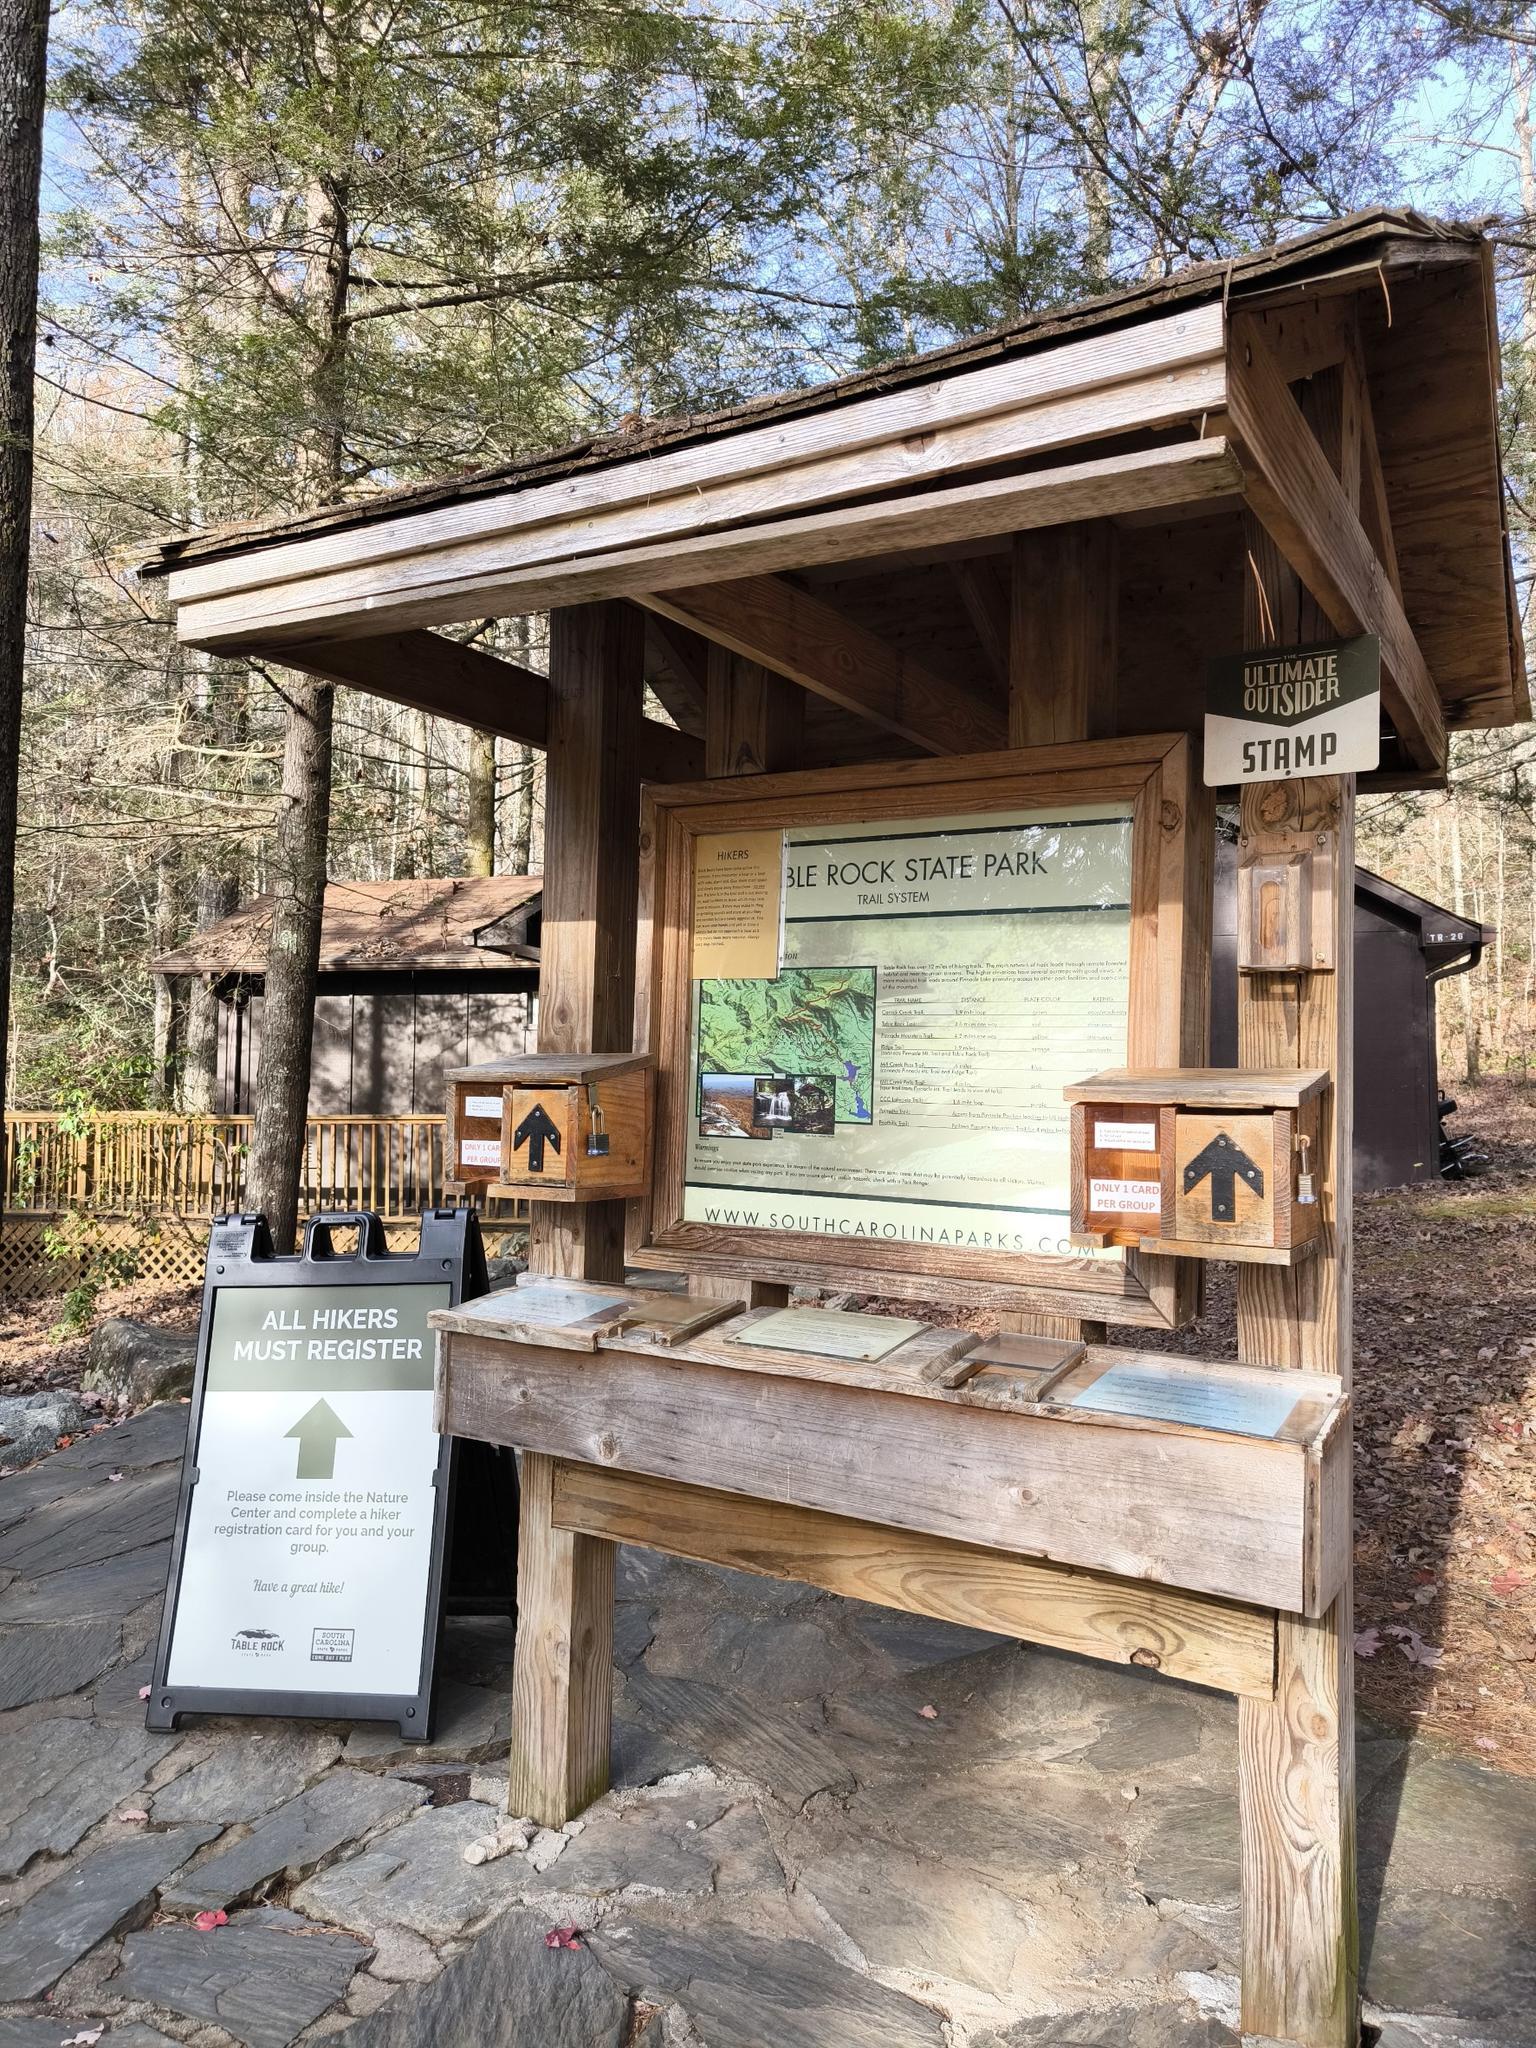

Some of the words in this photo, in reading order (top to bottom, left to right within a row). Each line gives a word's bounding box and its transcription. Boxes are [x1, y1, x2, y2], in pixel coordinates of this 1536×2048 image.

[1244, 655, 1338, 688] ULTIMATE
[1243, 677, 1340, 717] OUTSIDER
[1242, 732, 1337, 774] STAMP
[717, 849, 750, 861] HIKERS
[827, 859, 895, 886] ROCK
[904, 855, 973, 882] STATE
[984, 851, 1049, 877] PARK
[857, 894, 884, 905] TRAIL
[887, 891, 930, 904] SYSTEM
[1093, 1183, 1120, 1193] ONLY
[1123, 1185, 1129, 1194] 1
[1131, 1185, 1160, 1195] CARD
[1097, 1199, 1116, 1208] PER
[1118, 1200, 1156, 1210] GROUP
[262, 1310, 306, 1331] ALL
[312, 1308, 399, 1330] HIKERS
[233, 1340, 302, 1361] MUST
[307, 1338, 423, 1361] REGISTER
[227, 1490, 266, 1502] Please
[269, 1493, 302, 1503] come
[304, 1491, 341, 1503] inside
[343, 1491, 363, 1503] the
[366, 1491, 409, 1504] Nature
[230, 1506, 271, 1518] Center
[273, 1507, 296, 1519] and
[299, 1507, 357, 1522] complete
[359, 1511, 367, 1520] a
[370, 1508, 402, 1520] hiker
[214, 1523, 283, 1537] registration
[285, 1524, 312, 1536] card
[315, 1524, 333, 1536] for
[335, 1527, 358, 1540] you
[360, 1525, 384, 1537] and
[386, 1527, 415, 1540] your
[290, 1543, 329, 1556] group.
[253, 1578, 279, 1593] Have
[280, 1584, 288, 1593] a
[289, 1581, 318, 1598] great
[319, 1581, 345, 1594] hike!
[231, 1638, 258, 1651] TABLE
[261, 1640, 285, 1651] ROCK
